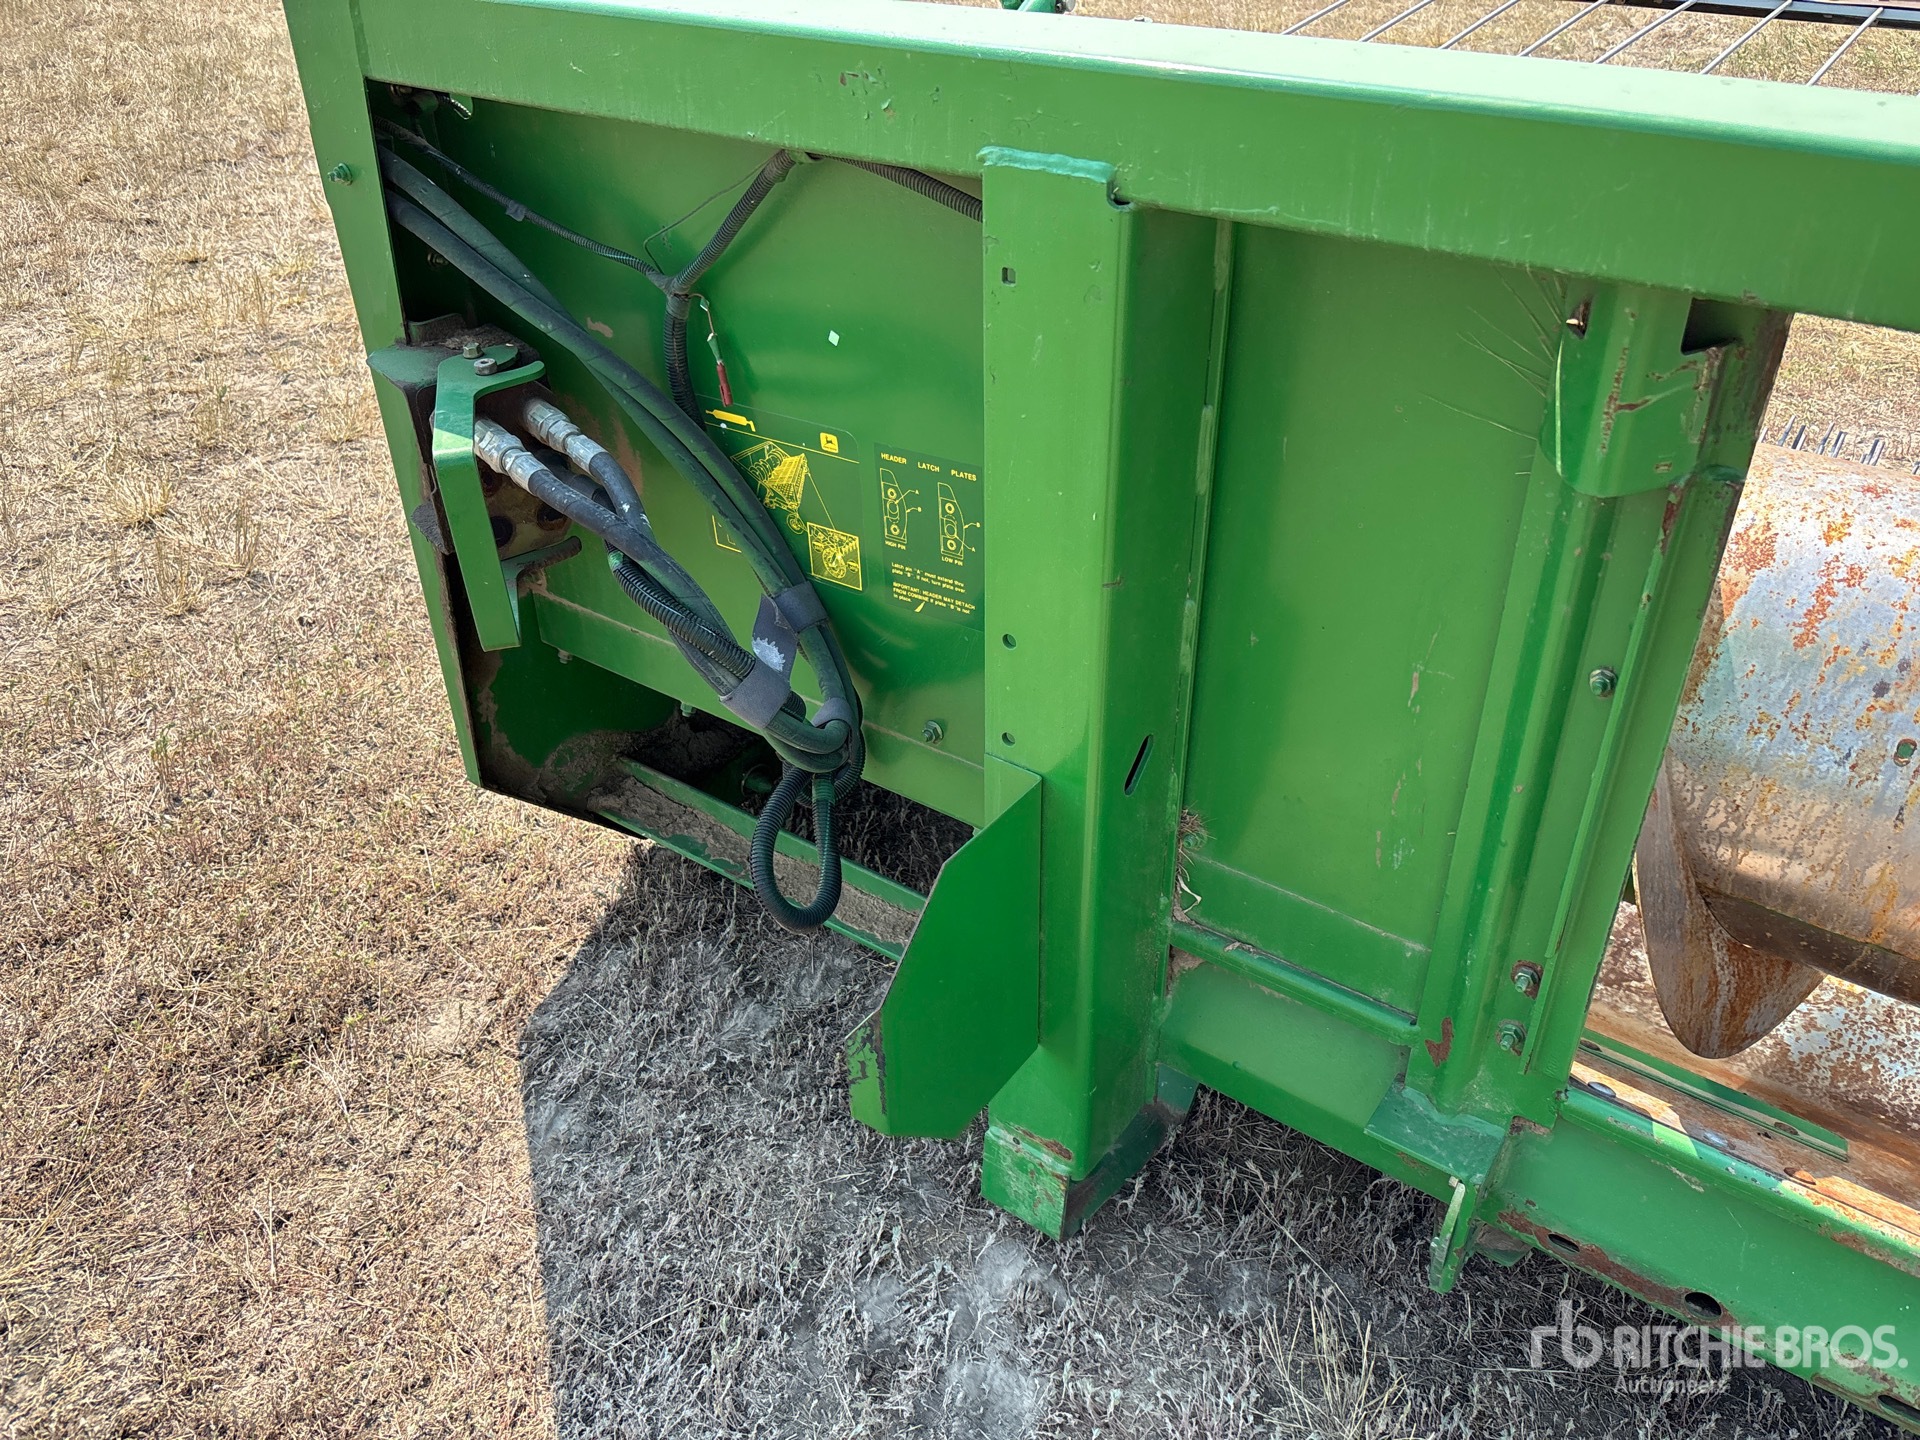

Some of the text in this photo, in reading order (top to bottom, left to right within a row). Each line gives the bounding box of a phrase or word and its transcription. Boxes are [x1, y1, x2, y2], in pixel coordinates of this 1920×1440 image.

[881, 453, 976, 481] HEADER LATCH PLATES
[923, 590, 942, 600] HEADER
